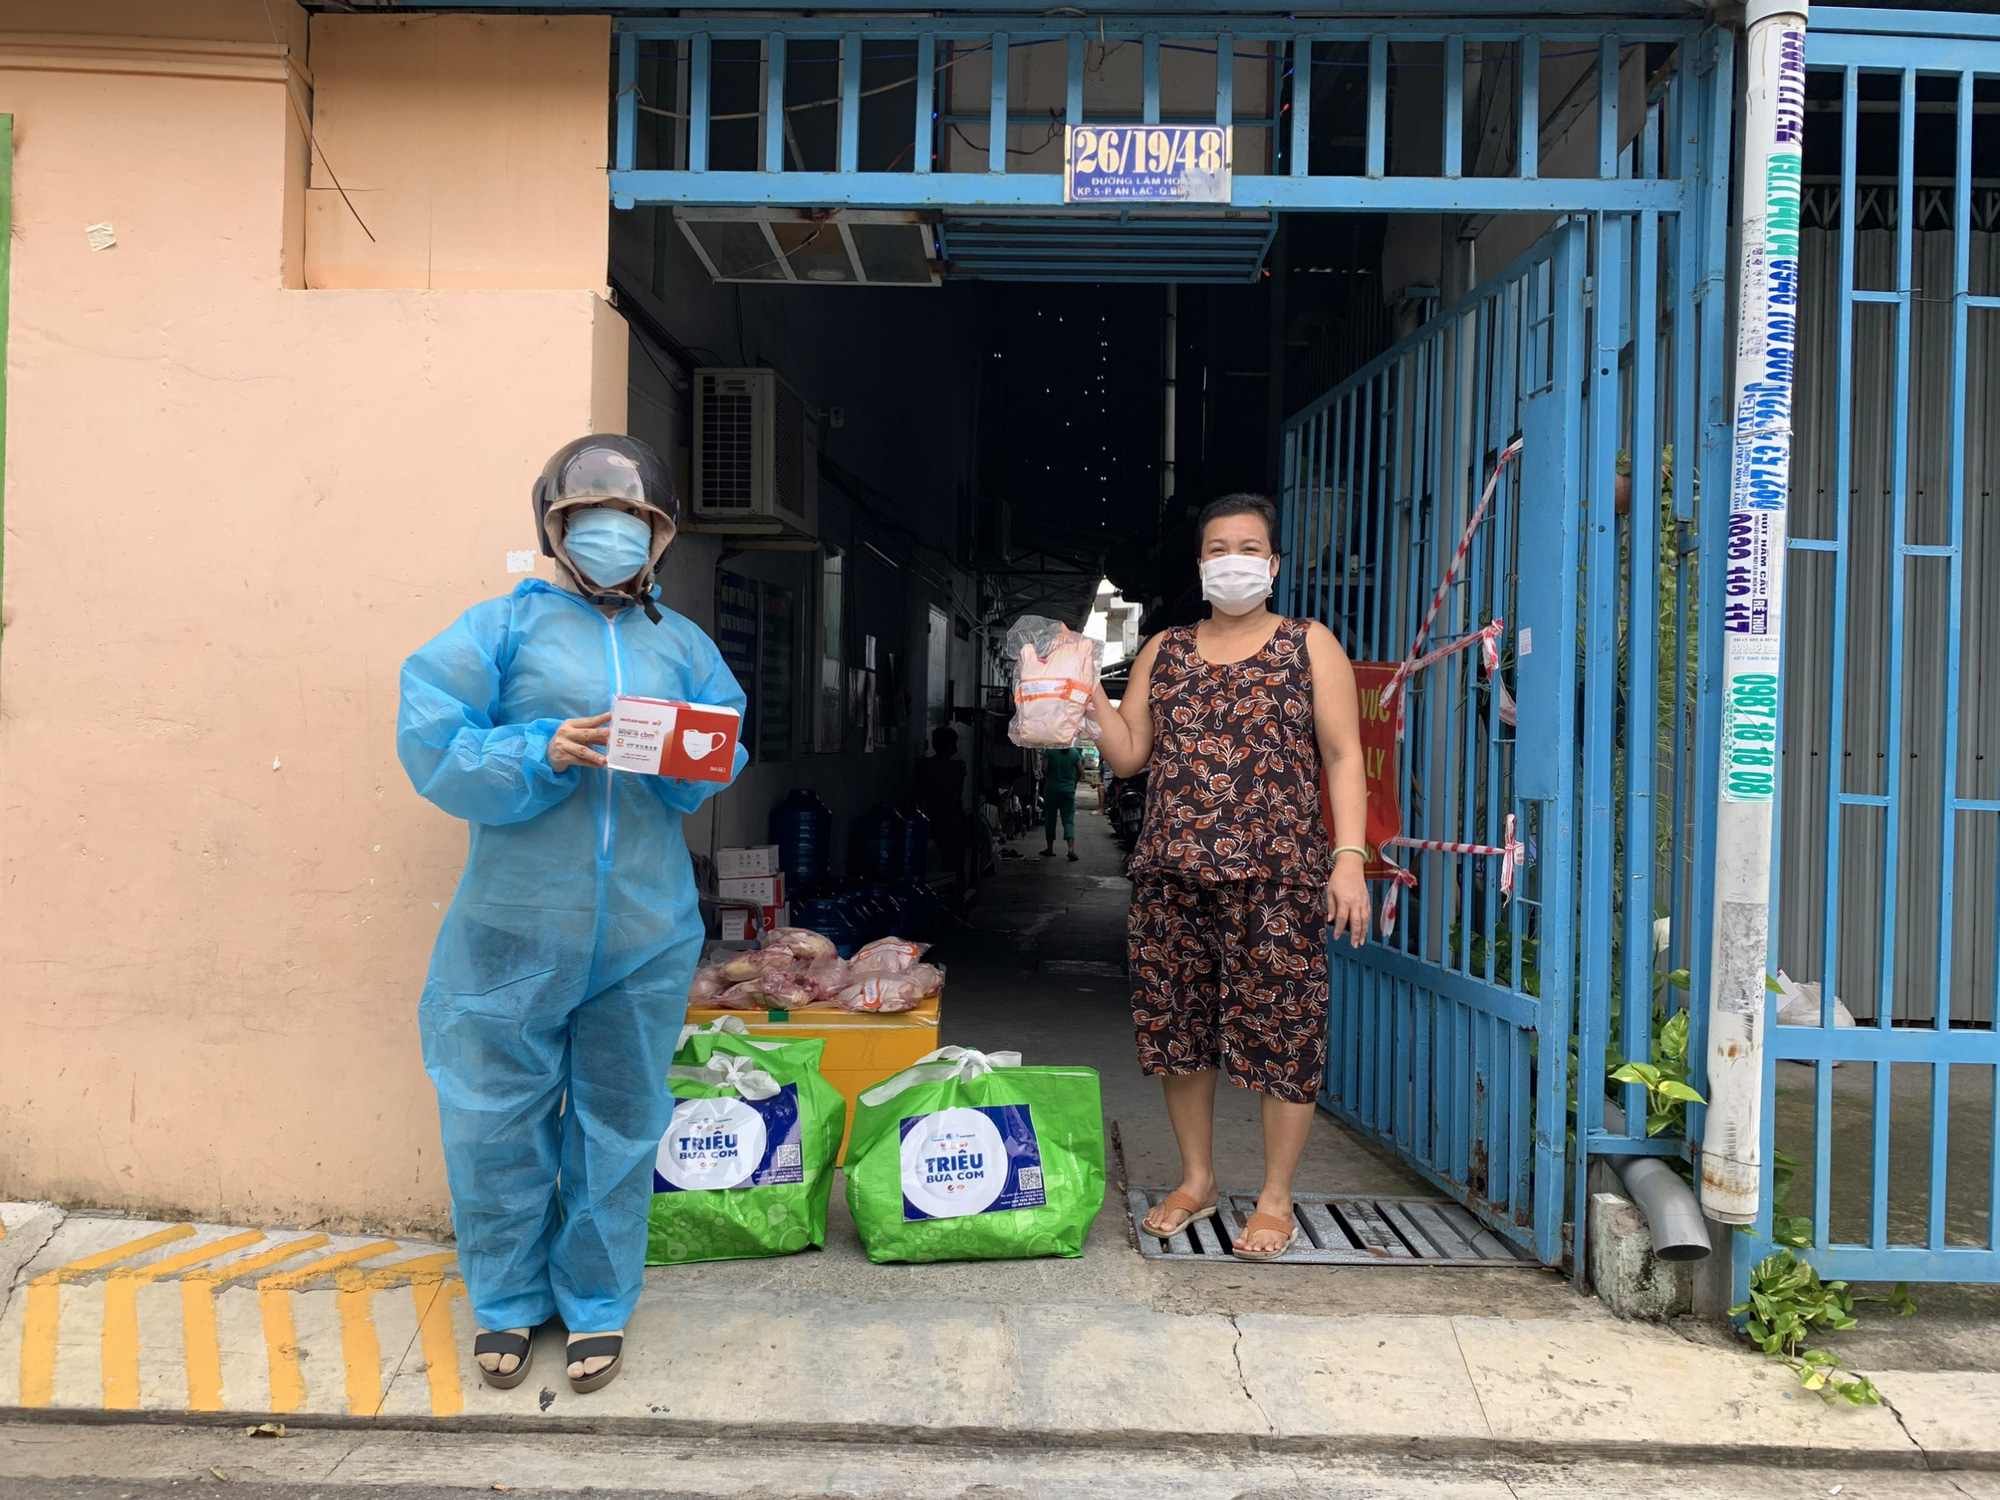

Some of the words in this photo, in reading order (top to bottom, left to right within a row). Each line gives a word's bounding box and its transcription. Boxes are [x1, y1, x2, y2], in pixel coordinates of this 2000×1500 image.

[1076, 130, 1221, 174] 26/19/48
[1136, 175, 1161, 186] LÂM
[1164, 177, 1181, 185] HO
[1115, 187, 1130, 196] AN
[1725, 603, 1750, 633] 117
